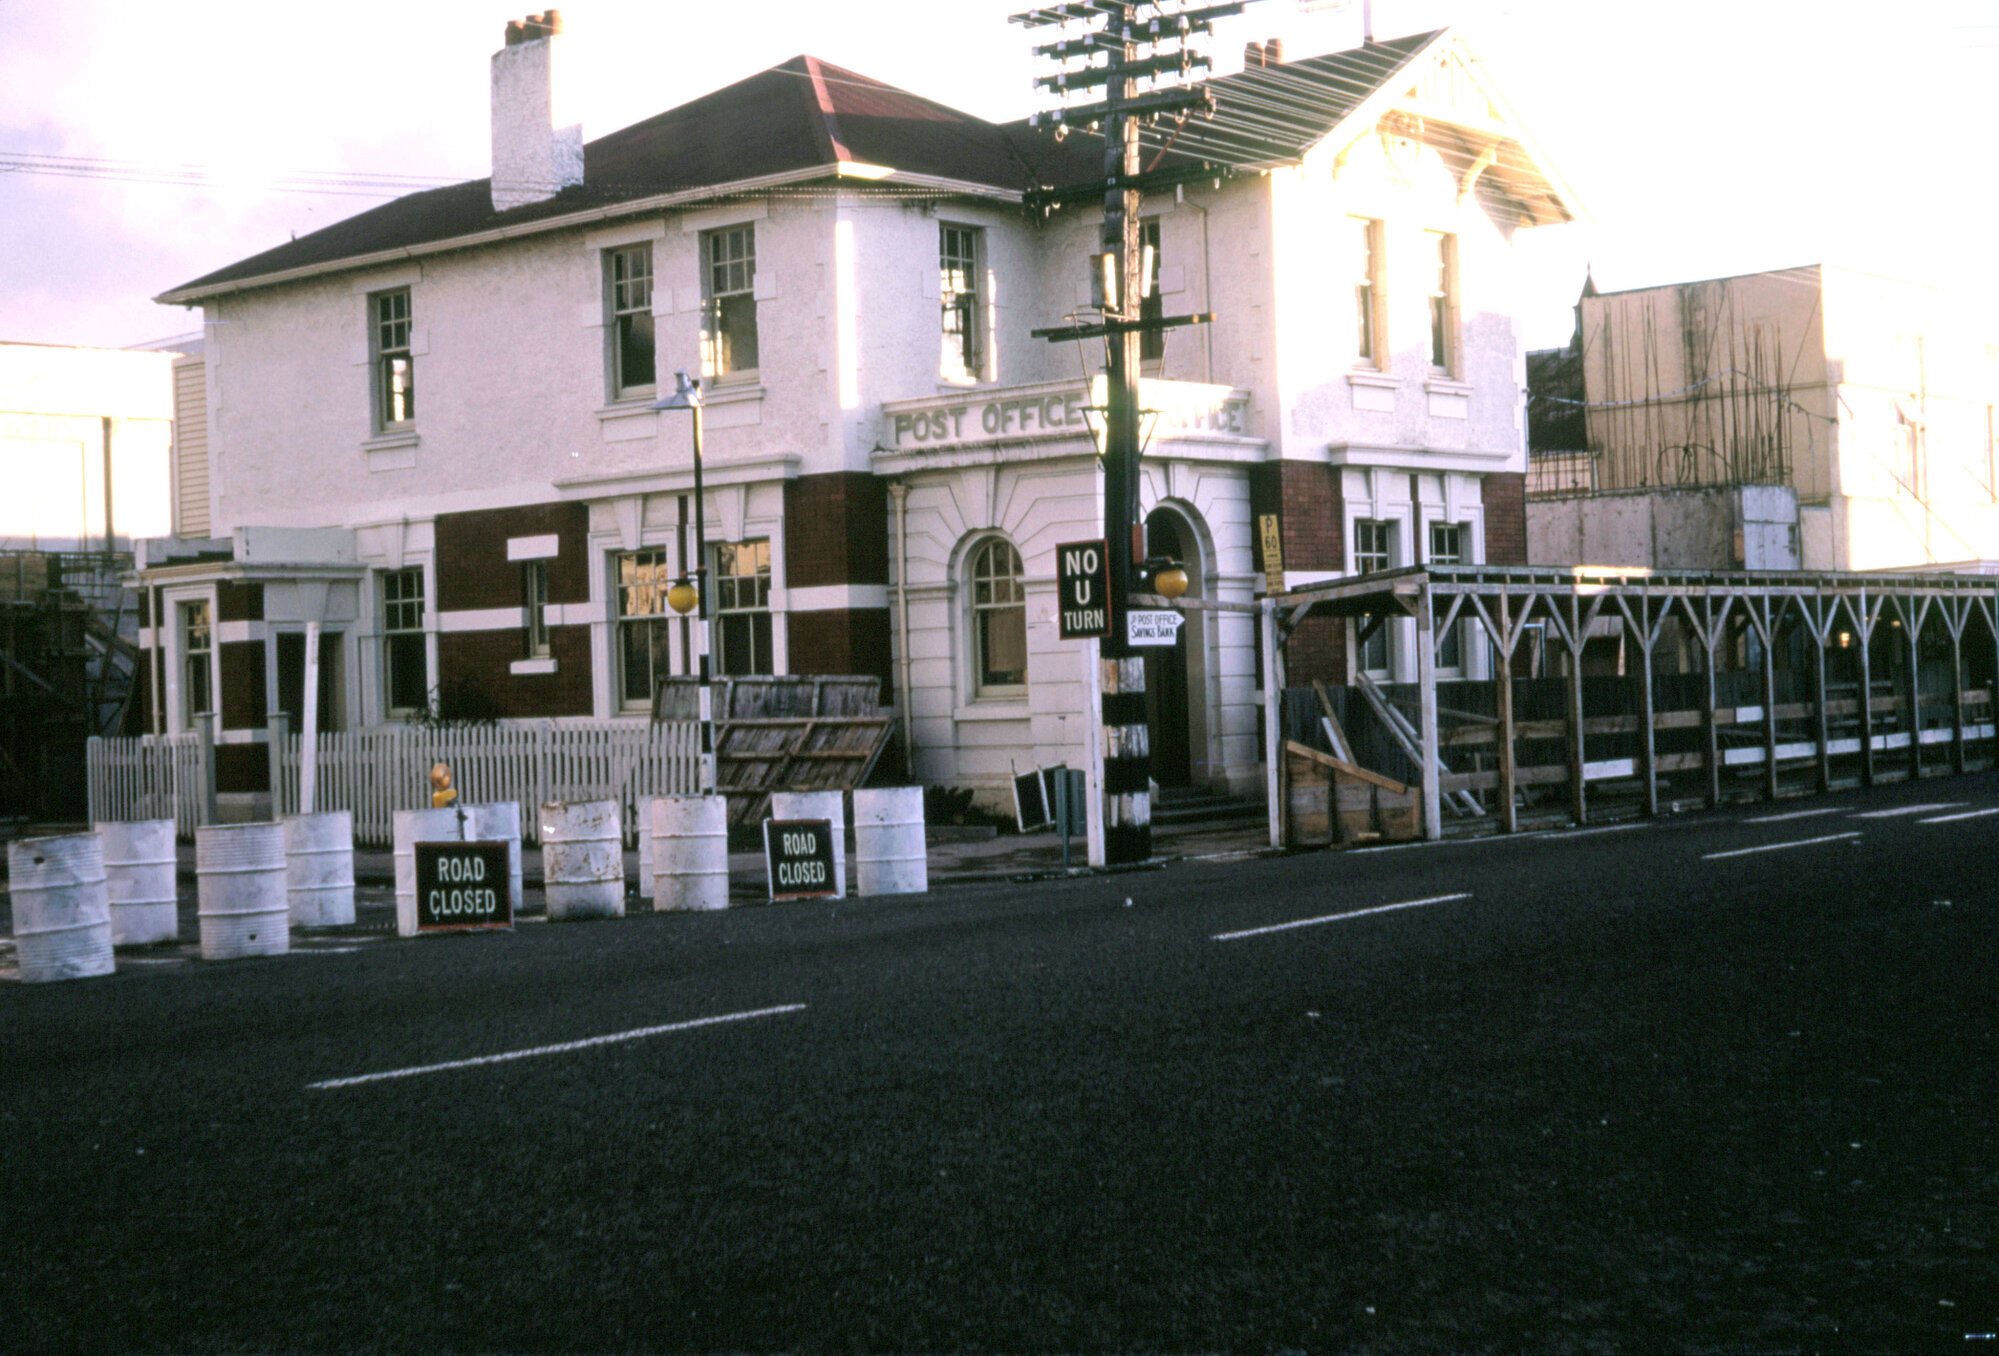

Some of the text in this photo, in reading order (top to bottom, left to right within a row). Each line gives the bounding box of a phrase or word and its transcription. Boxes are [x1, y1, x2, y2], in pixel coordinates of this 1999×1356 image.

[894, 392, 1083, 444] POST OFFICE
[1265, 517, 1273, 534] P
[1264, 536, 1278, 550] 60
[1066, 549, 1098, 576] NO
[1075, 580, 1091, 605] U
[1064, 608, 1104, 631] TURN
[1138, 614, 1153, 625] POST
[1155, 614, 1178, 625] OFFICE
[783, 832, 817, 855] ROAD
[438, 857, 485, 882] ROAD
[779, 861, 826, 885] CLOSED
[430, 889, 496, 915] CLOSED
